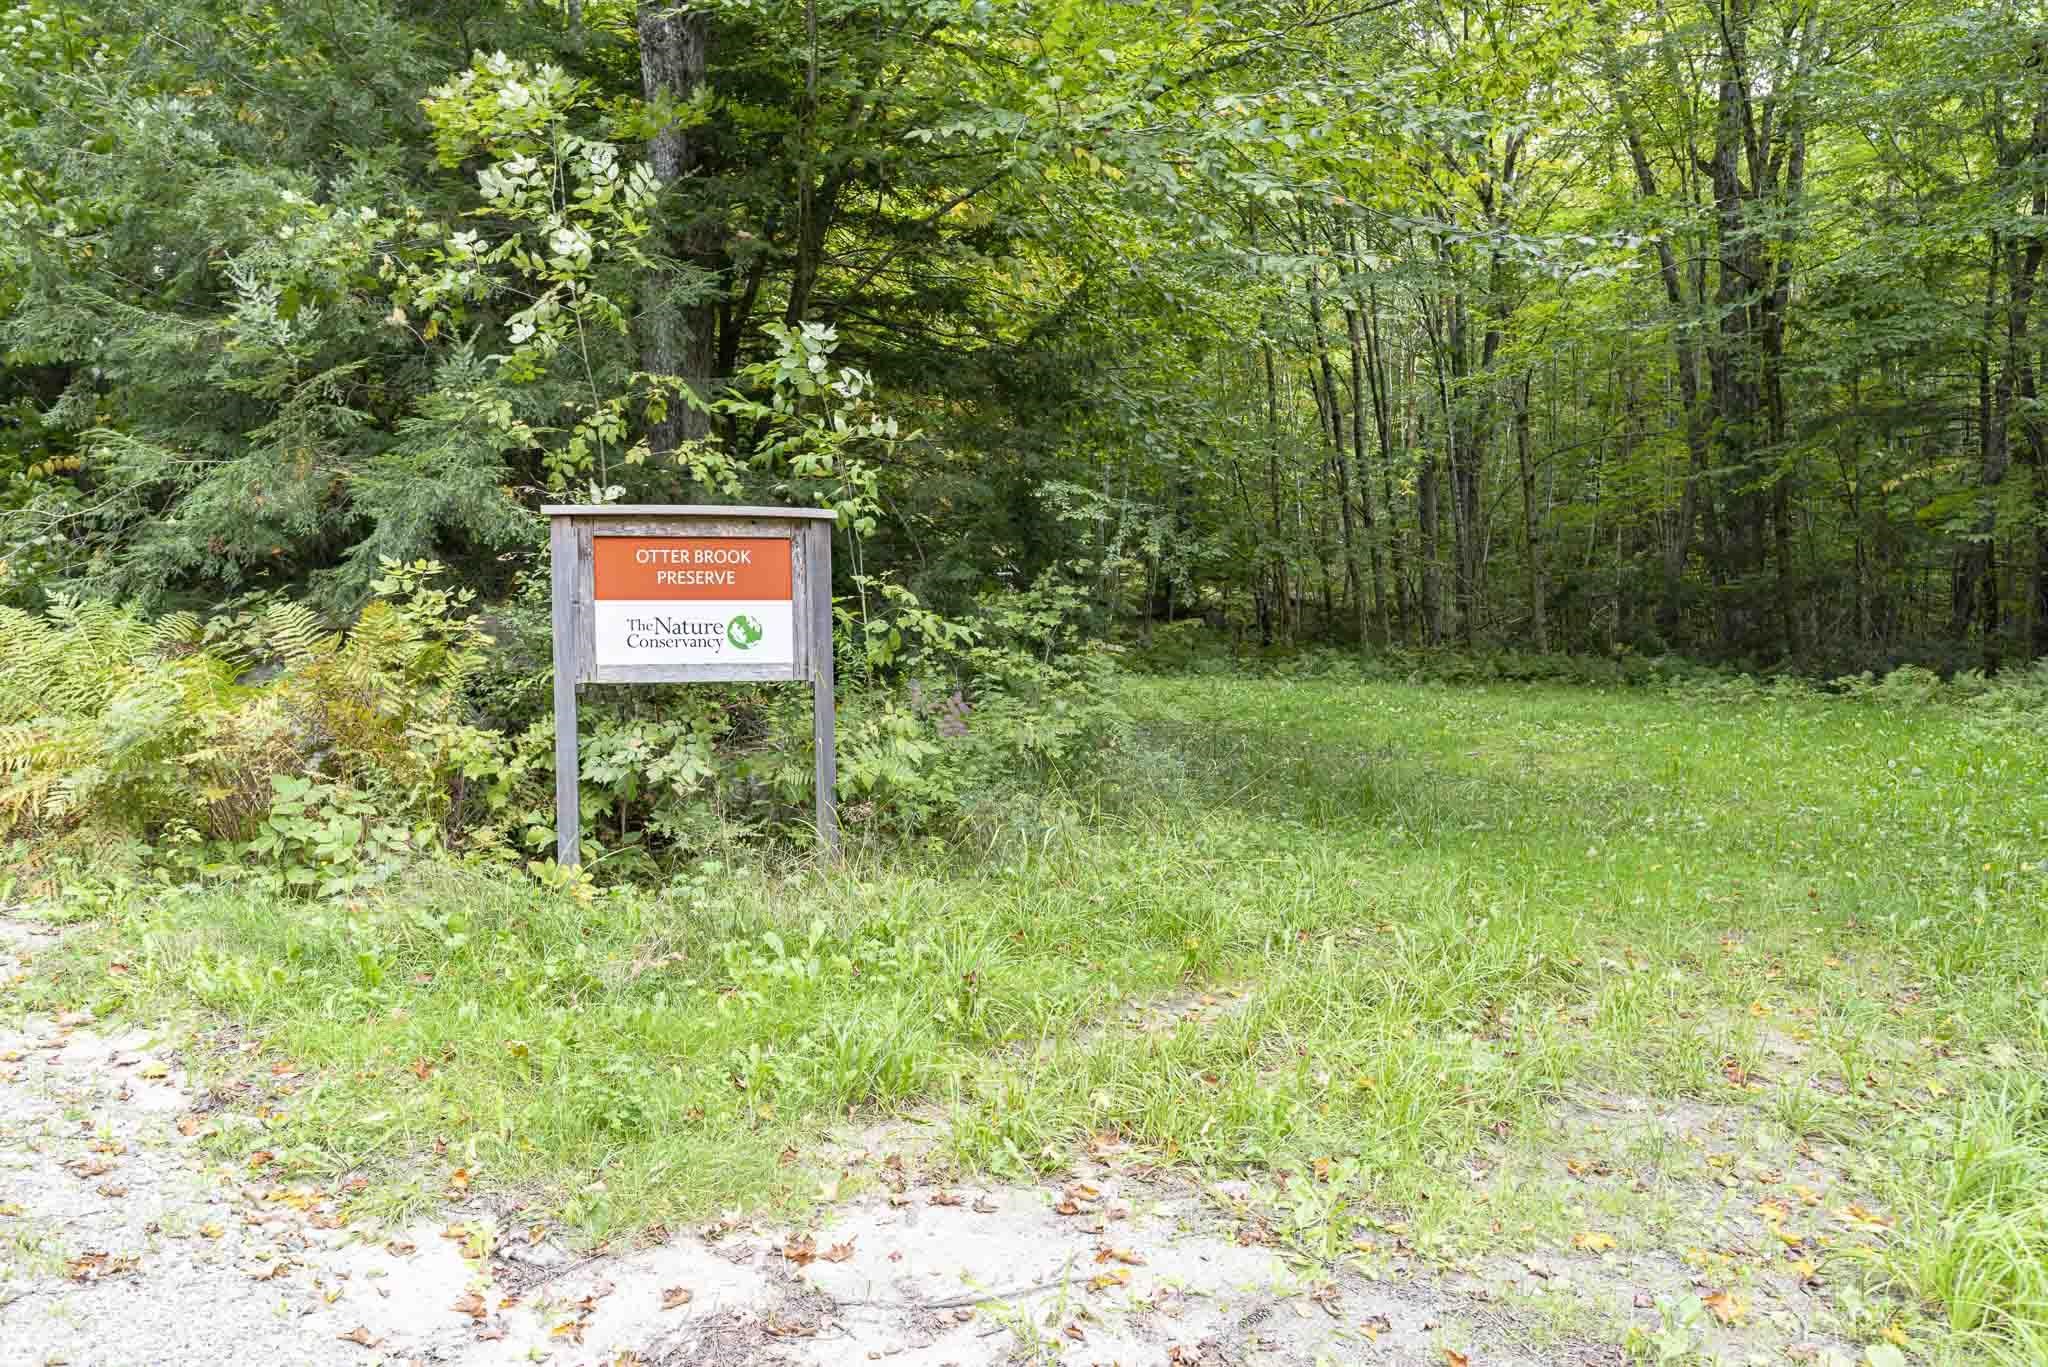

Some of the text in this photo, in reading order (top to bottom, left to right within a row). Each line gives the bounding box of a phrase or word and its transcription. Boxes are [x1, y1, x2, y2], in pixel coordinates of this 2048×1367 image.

[636, 549, 751, 564] OTTER BROOK
[656, 570, 736, 585] PRESERVE
[626, 616, 724, 635] The Nature
[626, 634, 724, 654] Conservancy
